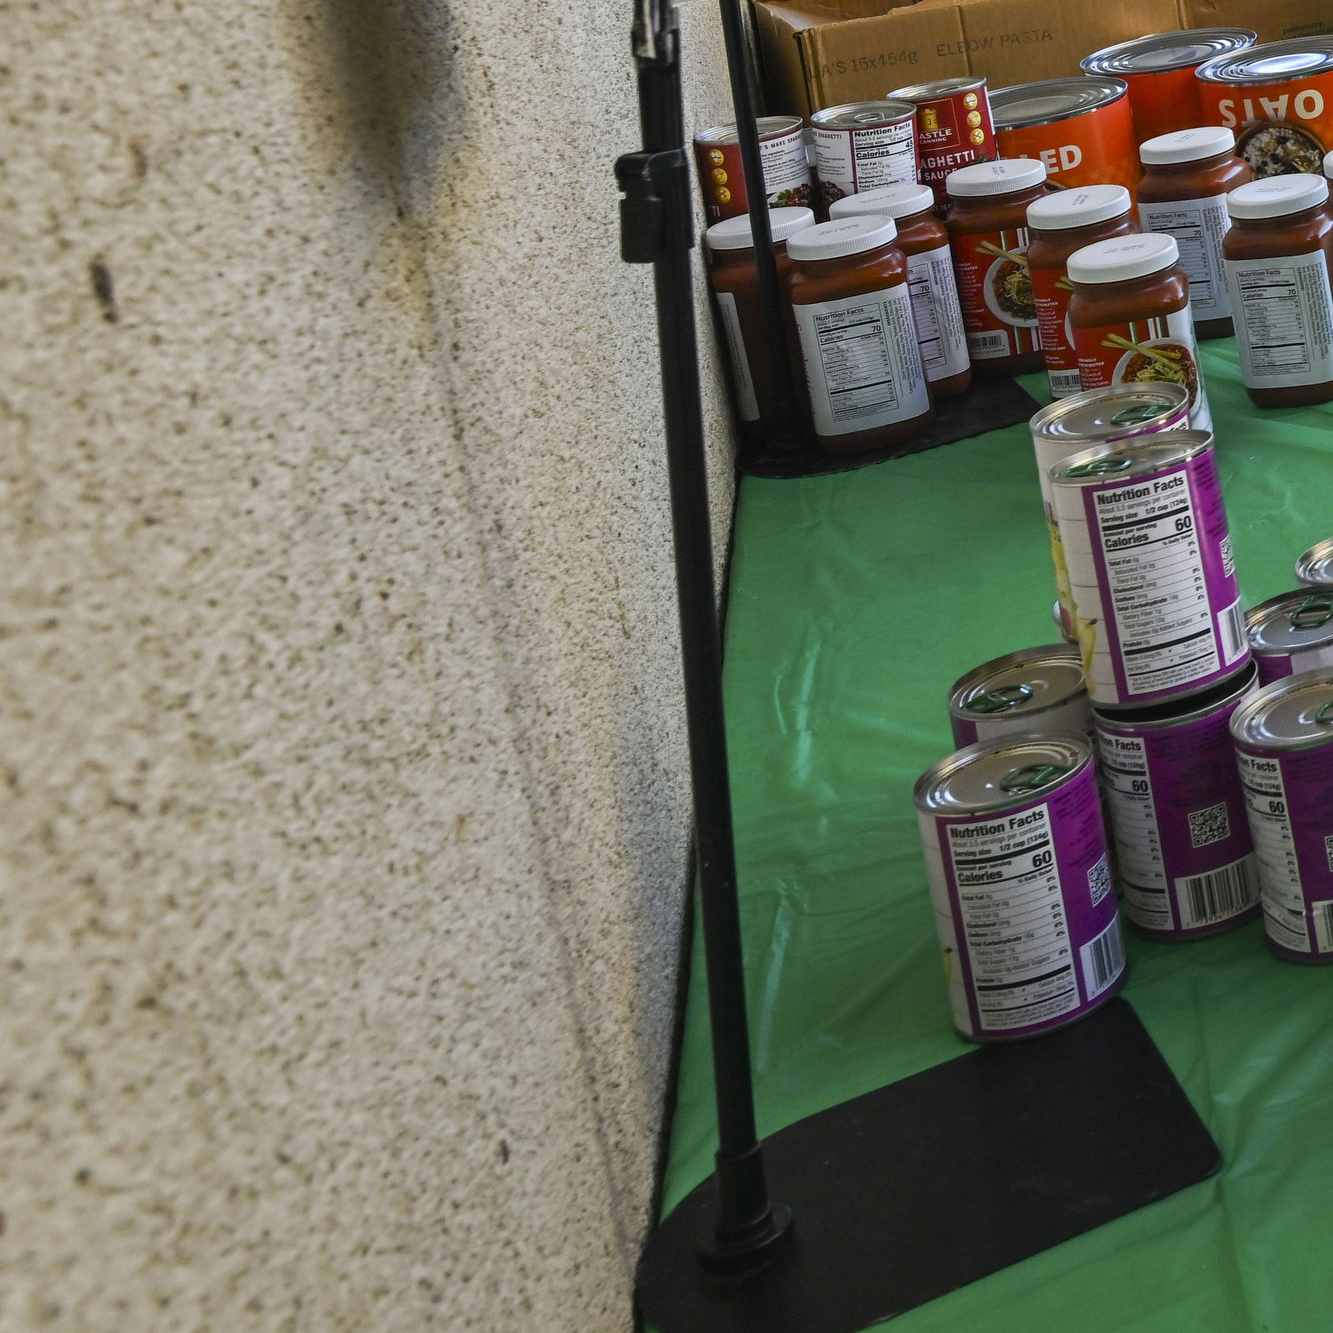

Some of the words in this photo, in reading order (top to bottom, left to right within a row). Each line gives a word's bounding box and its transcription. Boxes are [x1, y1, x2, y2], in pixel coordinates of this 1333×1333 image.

[936, 36, 993, 57] ELBOW
[1001, 28, 1053, 47] PASTA
[1219, 89, 1324, 128] OATS
[855, 127, 892, 137] Nutrition
[894, 123, 910, 131] Facts
[919, 129, 952, 139] ASTLE
[906, 140, 913, 148] 45
[856, 149, 890, 158] Calories
[920, 149, 975, 169] AGHETTI
[1039, 145, 1082, 175] ED
[925, 169, 957, 181] SAUC
[816, 311, 845, 321] Nutrition
[847, 307, 864, 315] Facts
[872, 325, 881, 333] 70
[820, 335, 843, 343] Calories
[1097, 487, 1150, 505] Nutrition
[1154, 477, 1184, 493] Facts
[1101, 514, 1124, 523] Serving
[1158, 504, 1168, 512] cup
[1175, 516, 1192, 531] 60
[1105, 533, 1149, 548] Calories
[1115, 739, 1142, 751] Facts
[1250, 760, 1277, 772] Facts
[1132, 780, 1149, 792] 60
[1269, 801, 1285, 814] 60
[950, 823, 1005, 838] Nutrition
[1009, 810, 1045, 830] Facts
[1012, 840, 1025, 848] cup
[1027, 831, 1048, 845] (124g)
[1032, 850, 1052, 868] 60
[958, 870, 1003, 882] Calories
